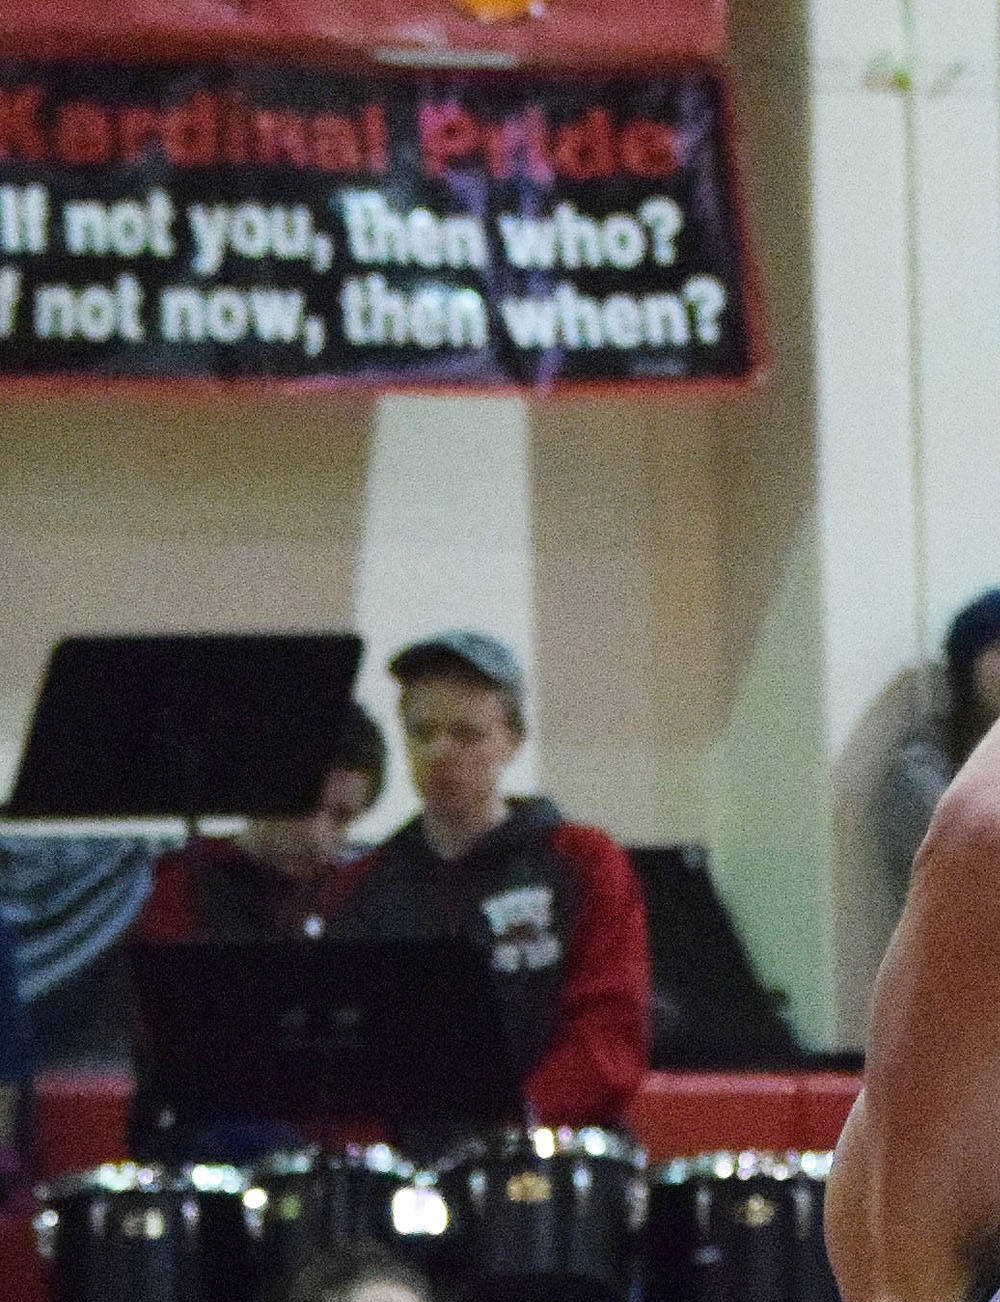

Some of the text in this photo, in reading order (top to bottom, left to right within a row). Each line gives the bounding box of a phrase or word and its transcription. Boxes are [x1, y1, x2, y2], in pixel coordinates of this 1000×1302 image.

[0, 86, 680, 184] Kardinal Pride
[62, 186, 174, 258] not
[188, 202, 334, 275] you,
[340, 188, 486, 269] then
[499, 196, 684, 269] who?
[34, 272, 145, 342] not
[160, 284, 327, 357] now,
[342, 274, 487, 347] then
[501, 273, 726, 348] when?
